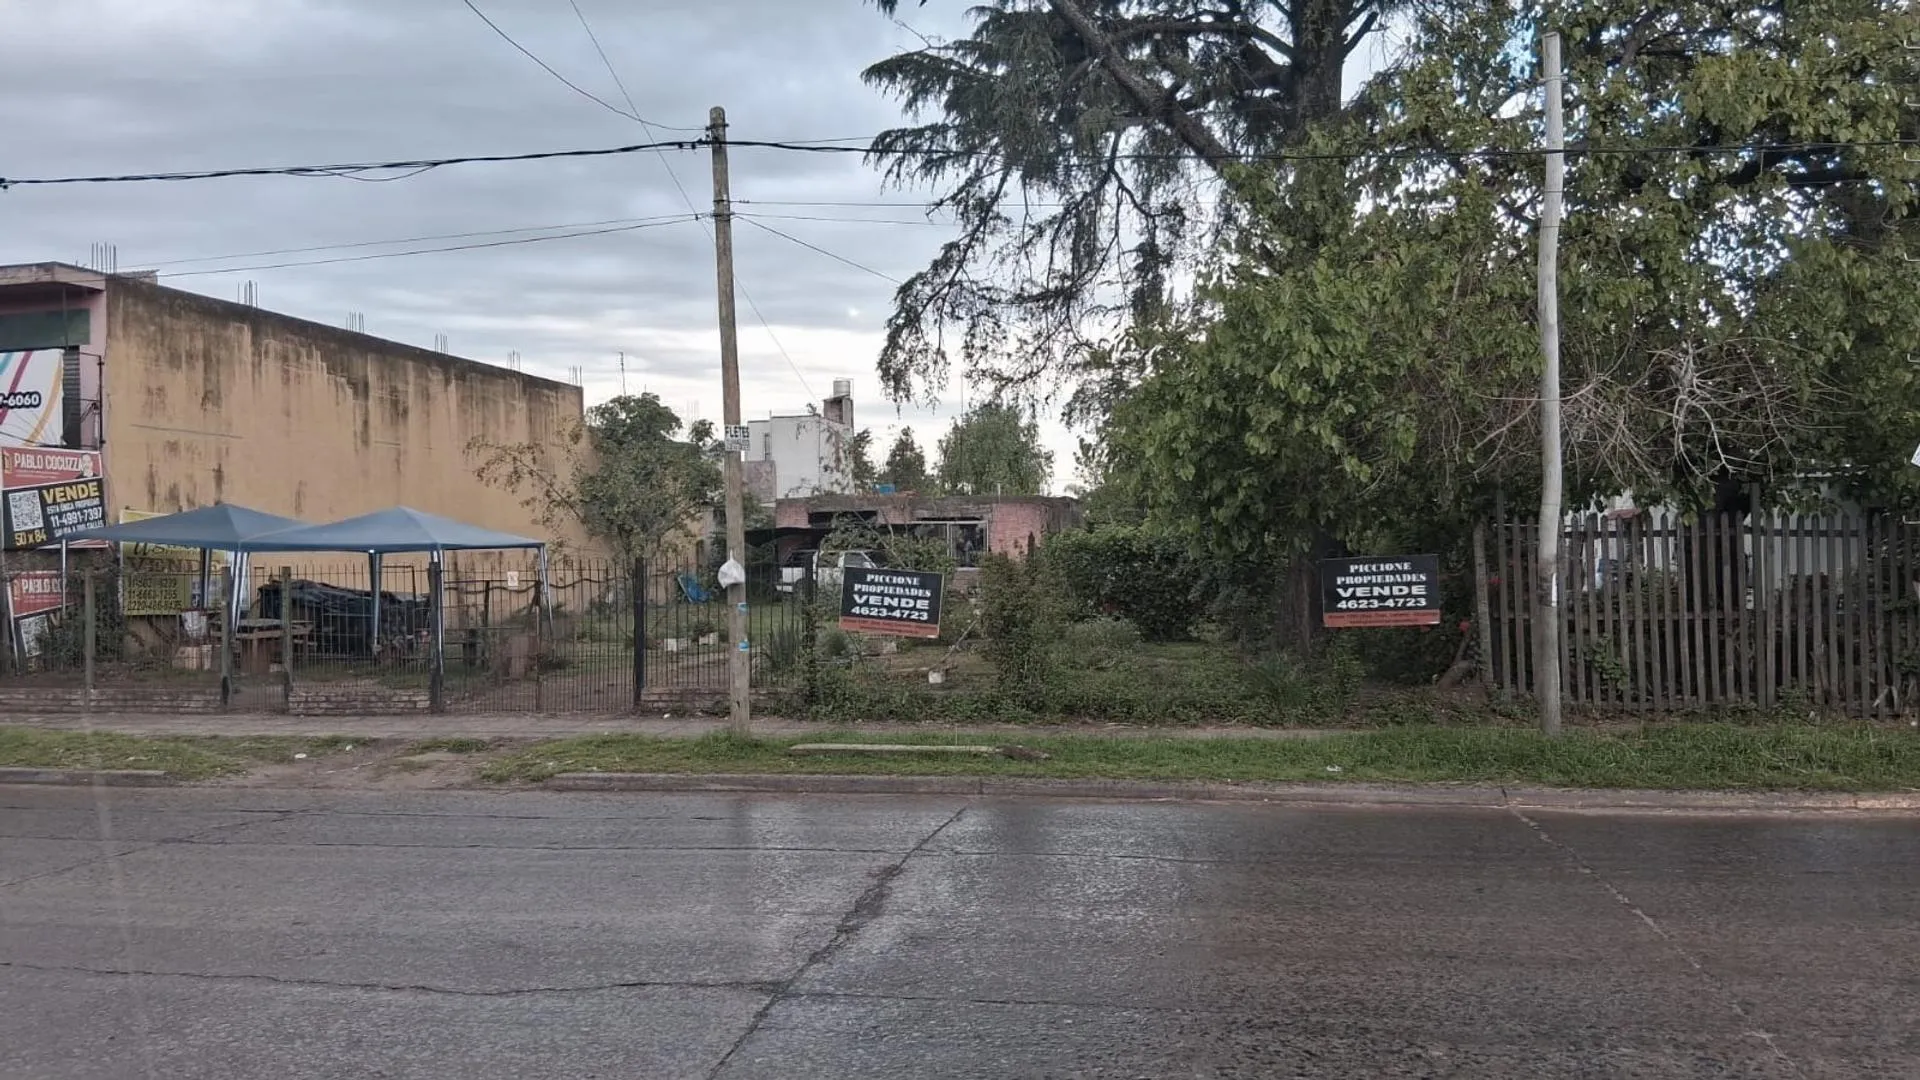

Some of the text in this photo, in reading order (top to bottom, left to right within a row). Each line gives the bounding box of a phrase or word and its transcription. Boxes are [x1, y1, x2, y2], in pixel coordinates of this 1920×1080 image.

[725, 426, 749, 438] FLETES
[14, 452, 43, 469] PABLO
[42, 482, 100, 504] VENDE
[50, 507, 102, 527] 11-4991-7397
[15, 531, 27, 546] 50
[34, 528, 47, 541] 84
[1349, 562, 1412, 573] PICCIONE
[21, 578, 51, 593] PABLO
[866, 573, 920, 586] PICCIONE
[1336, 573, 1427, 585] PROPIEDADES
[853, 583, 932, 598] PROPIEDADES
[1336, 585, 1428, 598] VENDE
[852, 593, 930, 610] VENDE
[1336, 597, 1428, 610] 4623-4723
[850, 606, 929, 621] 4623-4723
